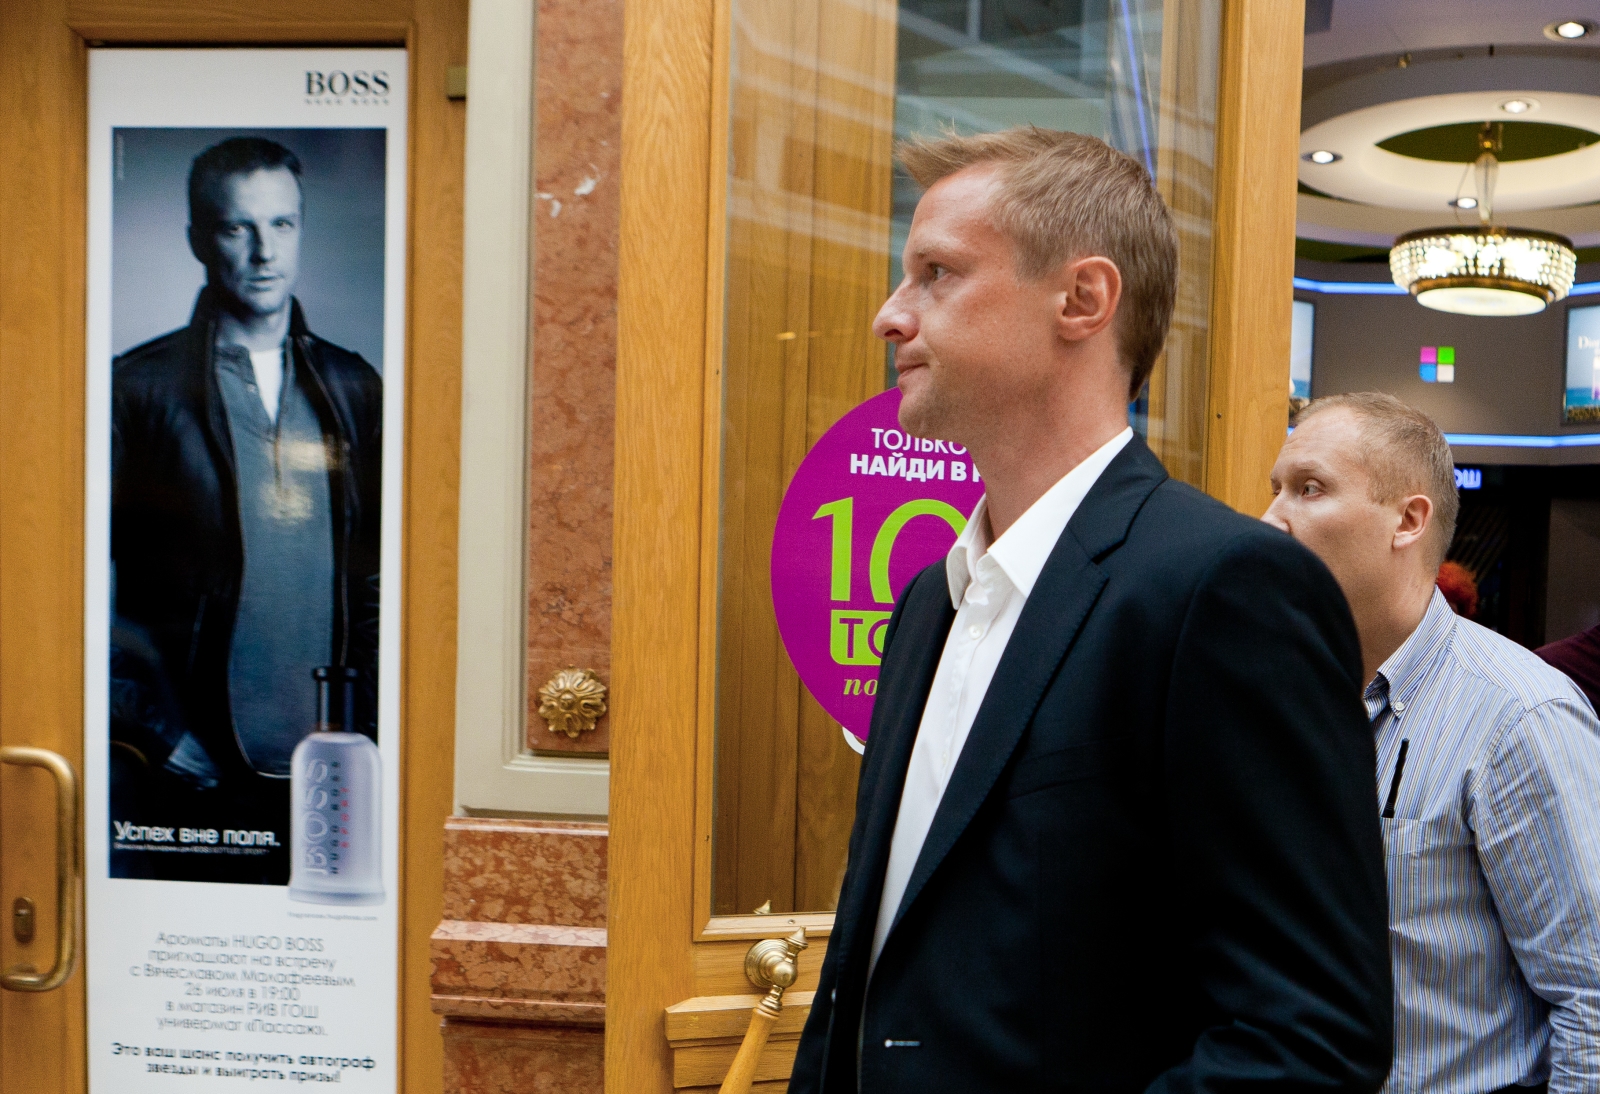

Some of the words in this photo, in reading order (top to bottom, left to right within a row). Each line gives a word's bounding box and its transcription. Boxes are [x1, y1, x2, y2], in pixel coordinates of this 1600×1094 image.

[305, 70, 389, 96] BOSS
[871, 427, 967, 455] ТОЛЬКО
[850, 452, 945, 482] НАЙДИ
[950, 461, 967, 481] В
[113, 820, 176, 842] Успех
[178, 827, 219, 844] вне
[223, 829, 281, 846] поля.
[156, 932, 229, 948] Ароматы
[232, 935, 282, 950] HUGO
[285, 937, 325, 952] BOSS
[148, 950, 247, 964] приглашают
[250, 954, 272, 966] на
[275, 955, 338, 971] встречу
[129, 965, 141, 977] с
[143, 964, 239, 981] Вячеславом
[248, 987, 256, 998] в
[261, 986, 300, 1001] 19:00
[165, 1001, 174, 1011] в
[177, 1003, 244, 1015] магазин
[247, 1002, 278, 1017] РИВ
[281, 1003, 319, 1018] ГОШ
[156, 1016, 243, 1031] универмаг
[112, 1042, 141, 1056] Это
[145, 1046, 176, 1058] ваш
[179, 1048, 221, 1061] шанс
[225, 1051, 295, 1065] получить
[298, 1055, 376, 1071] автограф
[146, 1063, 199, 1075] звезды
[202, 1066, 212, 1076] и
[216, 1067, 286, 1081] выиграть
[289, 1070, 341, 1083] призы!
